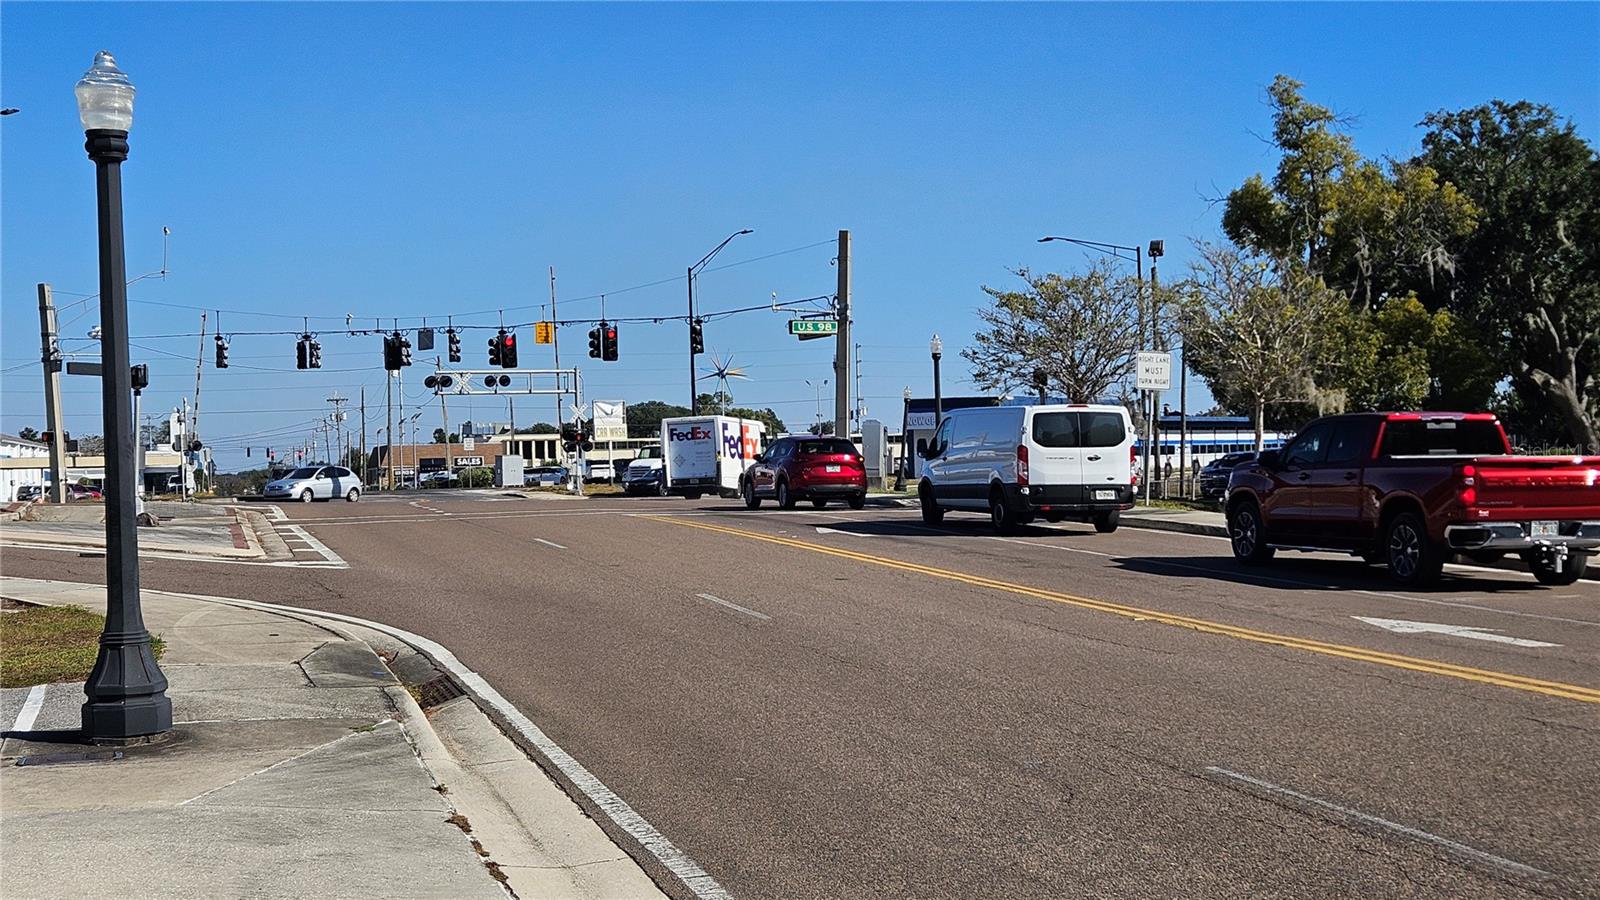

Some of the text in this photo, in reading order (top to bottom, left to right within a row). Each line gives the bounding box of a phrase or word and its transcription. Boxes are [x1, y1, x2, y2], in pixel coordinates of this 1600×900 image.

[817, 323, 832, 331] 98
[1145, 367, 1163, 375] MUST
[596, 427, 626, 438] CAR WASH
[670, 427, 711, 442] FedEx
[722, 422, 758, 460] FedEx
